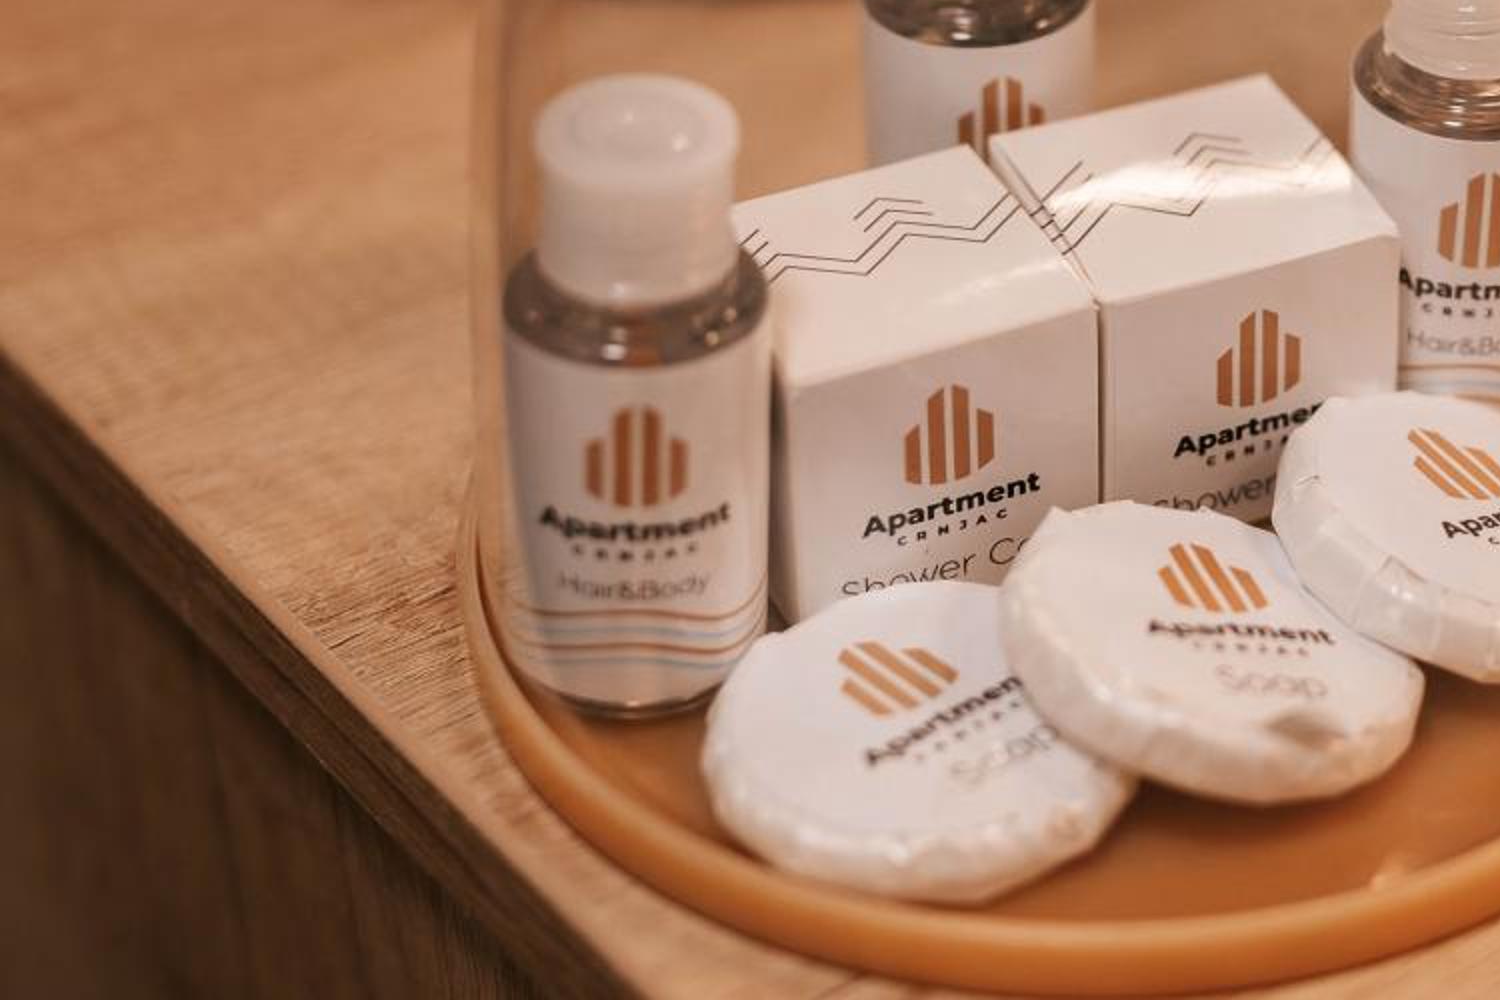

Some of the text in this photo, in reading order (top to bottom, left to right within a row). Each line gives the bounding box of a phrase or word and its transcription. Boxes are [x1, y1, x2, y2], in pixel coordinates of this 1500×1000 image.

[1173, 400, 1324, 458] Apartme
[538, 502, 730, 542] Apartment
[861, 472, 1040, 538] Apartment
[897, 508, 1008, 546] CRNJAC
[865, 674, 1024, 767] Apartmen
